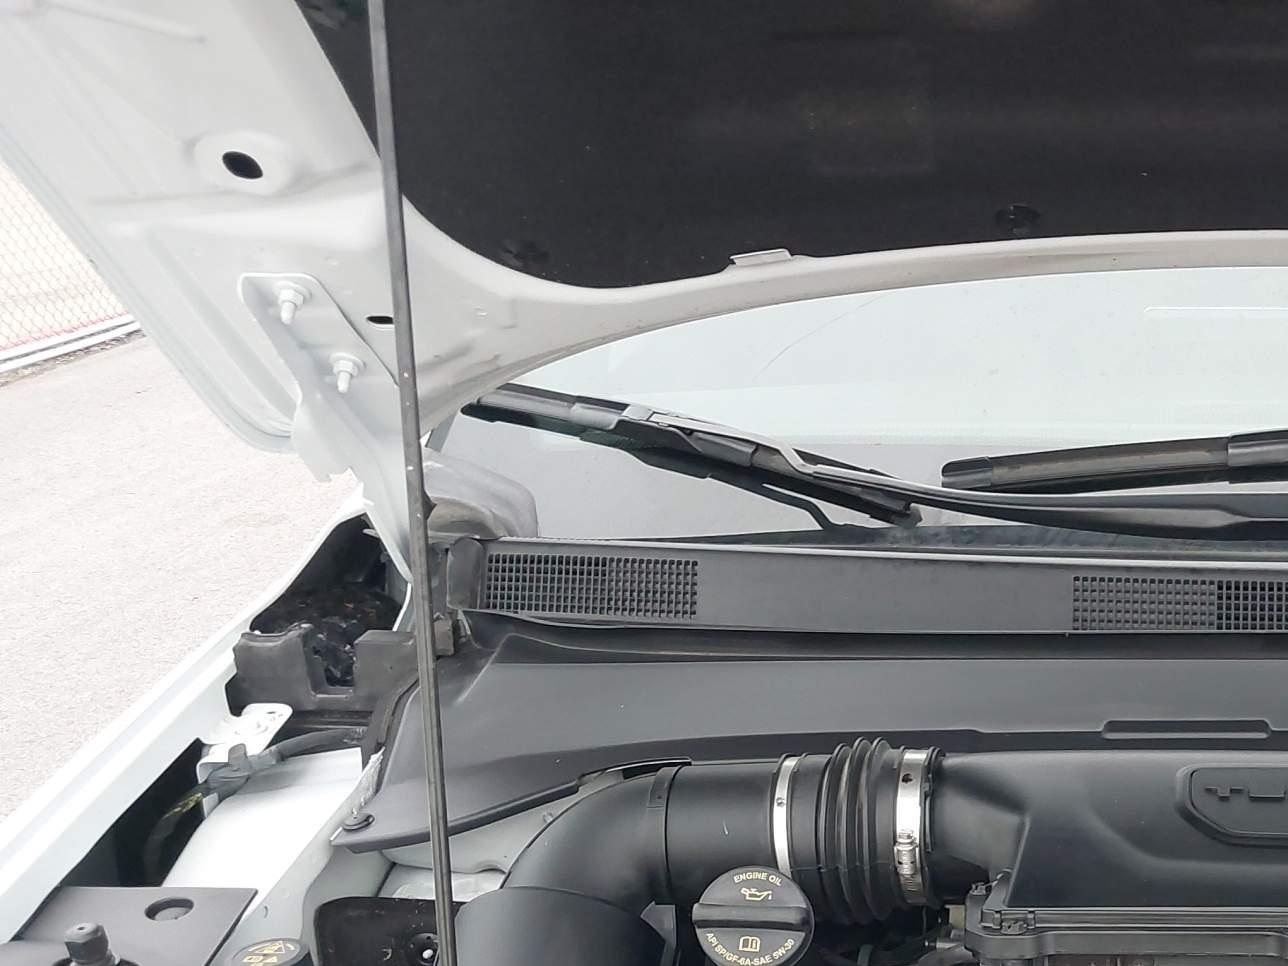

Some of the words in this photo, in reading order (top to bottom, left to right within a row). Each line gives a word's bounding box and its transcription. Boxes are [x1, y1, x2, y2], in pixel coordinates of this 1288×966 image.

[733, 872, 768, 884] ENGINE
[768, 874, 782, 886] OIL
[706, 933, 718, 947] API
[773, 938, 795, 960] 5W-30
